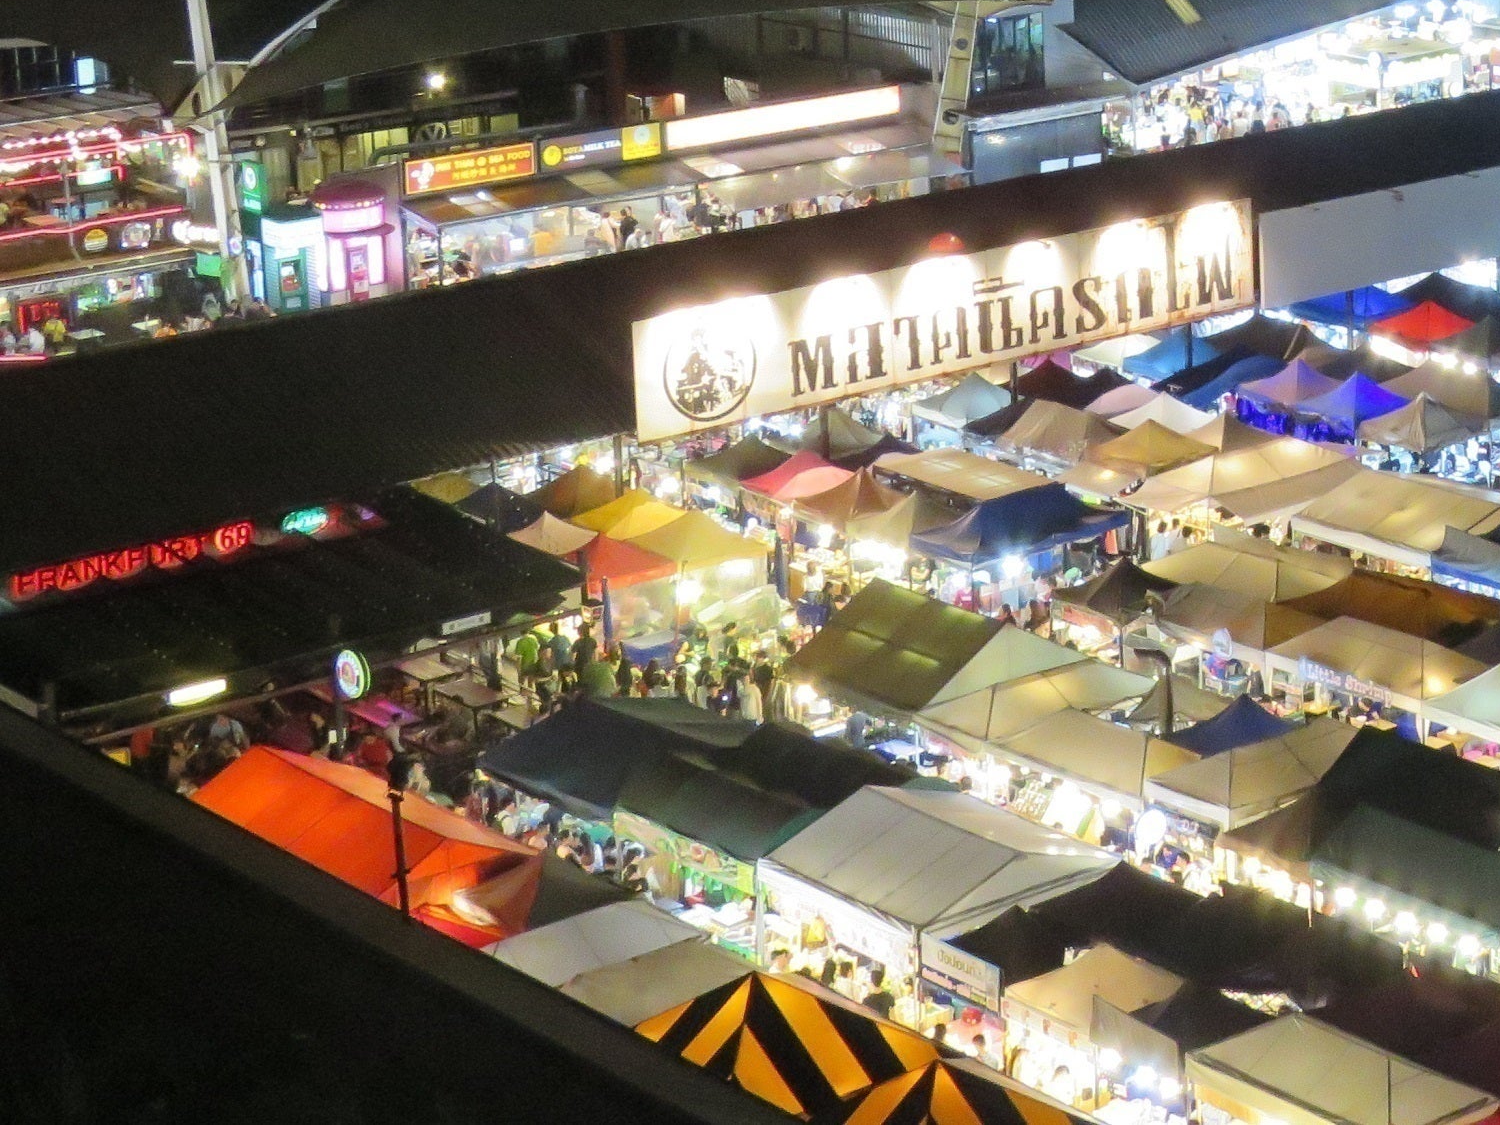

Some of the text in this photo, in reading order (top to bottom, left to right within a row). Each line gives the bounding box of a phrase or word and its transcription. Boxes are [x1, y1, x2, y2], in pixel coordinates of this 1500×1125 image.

[507, 150, 531, 160] FOOD
[216, 522, 252, 553] 69
[1306, 661, 1393, 709] Little Shrimp
